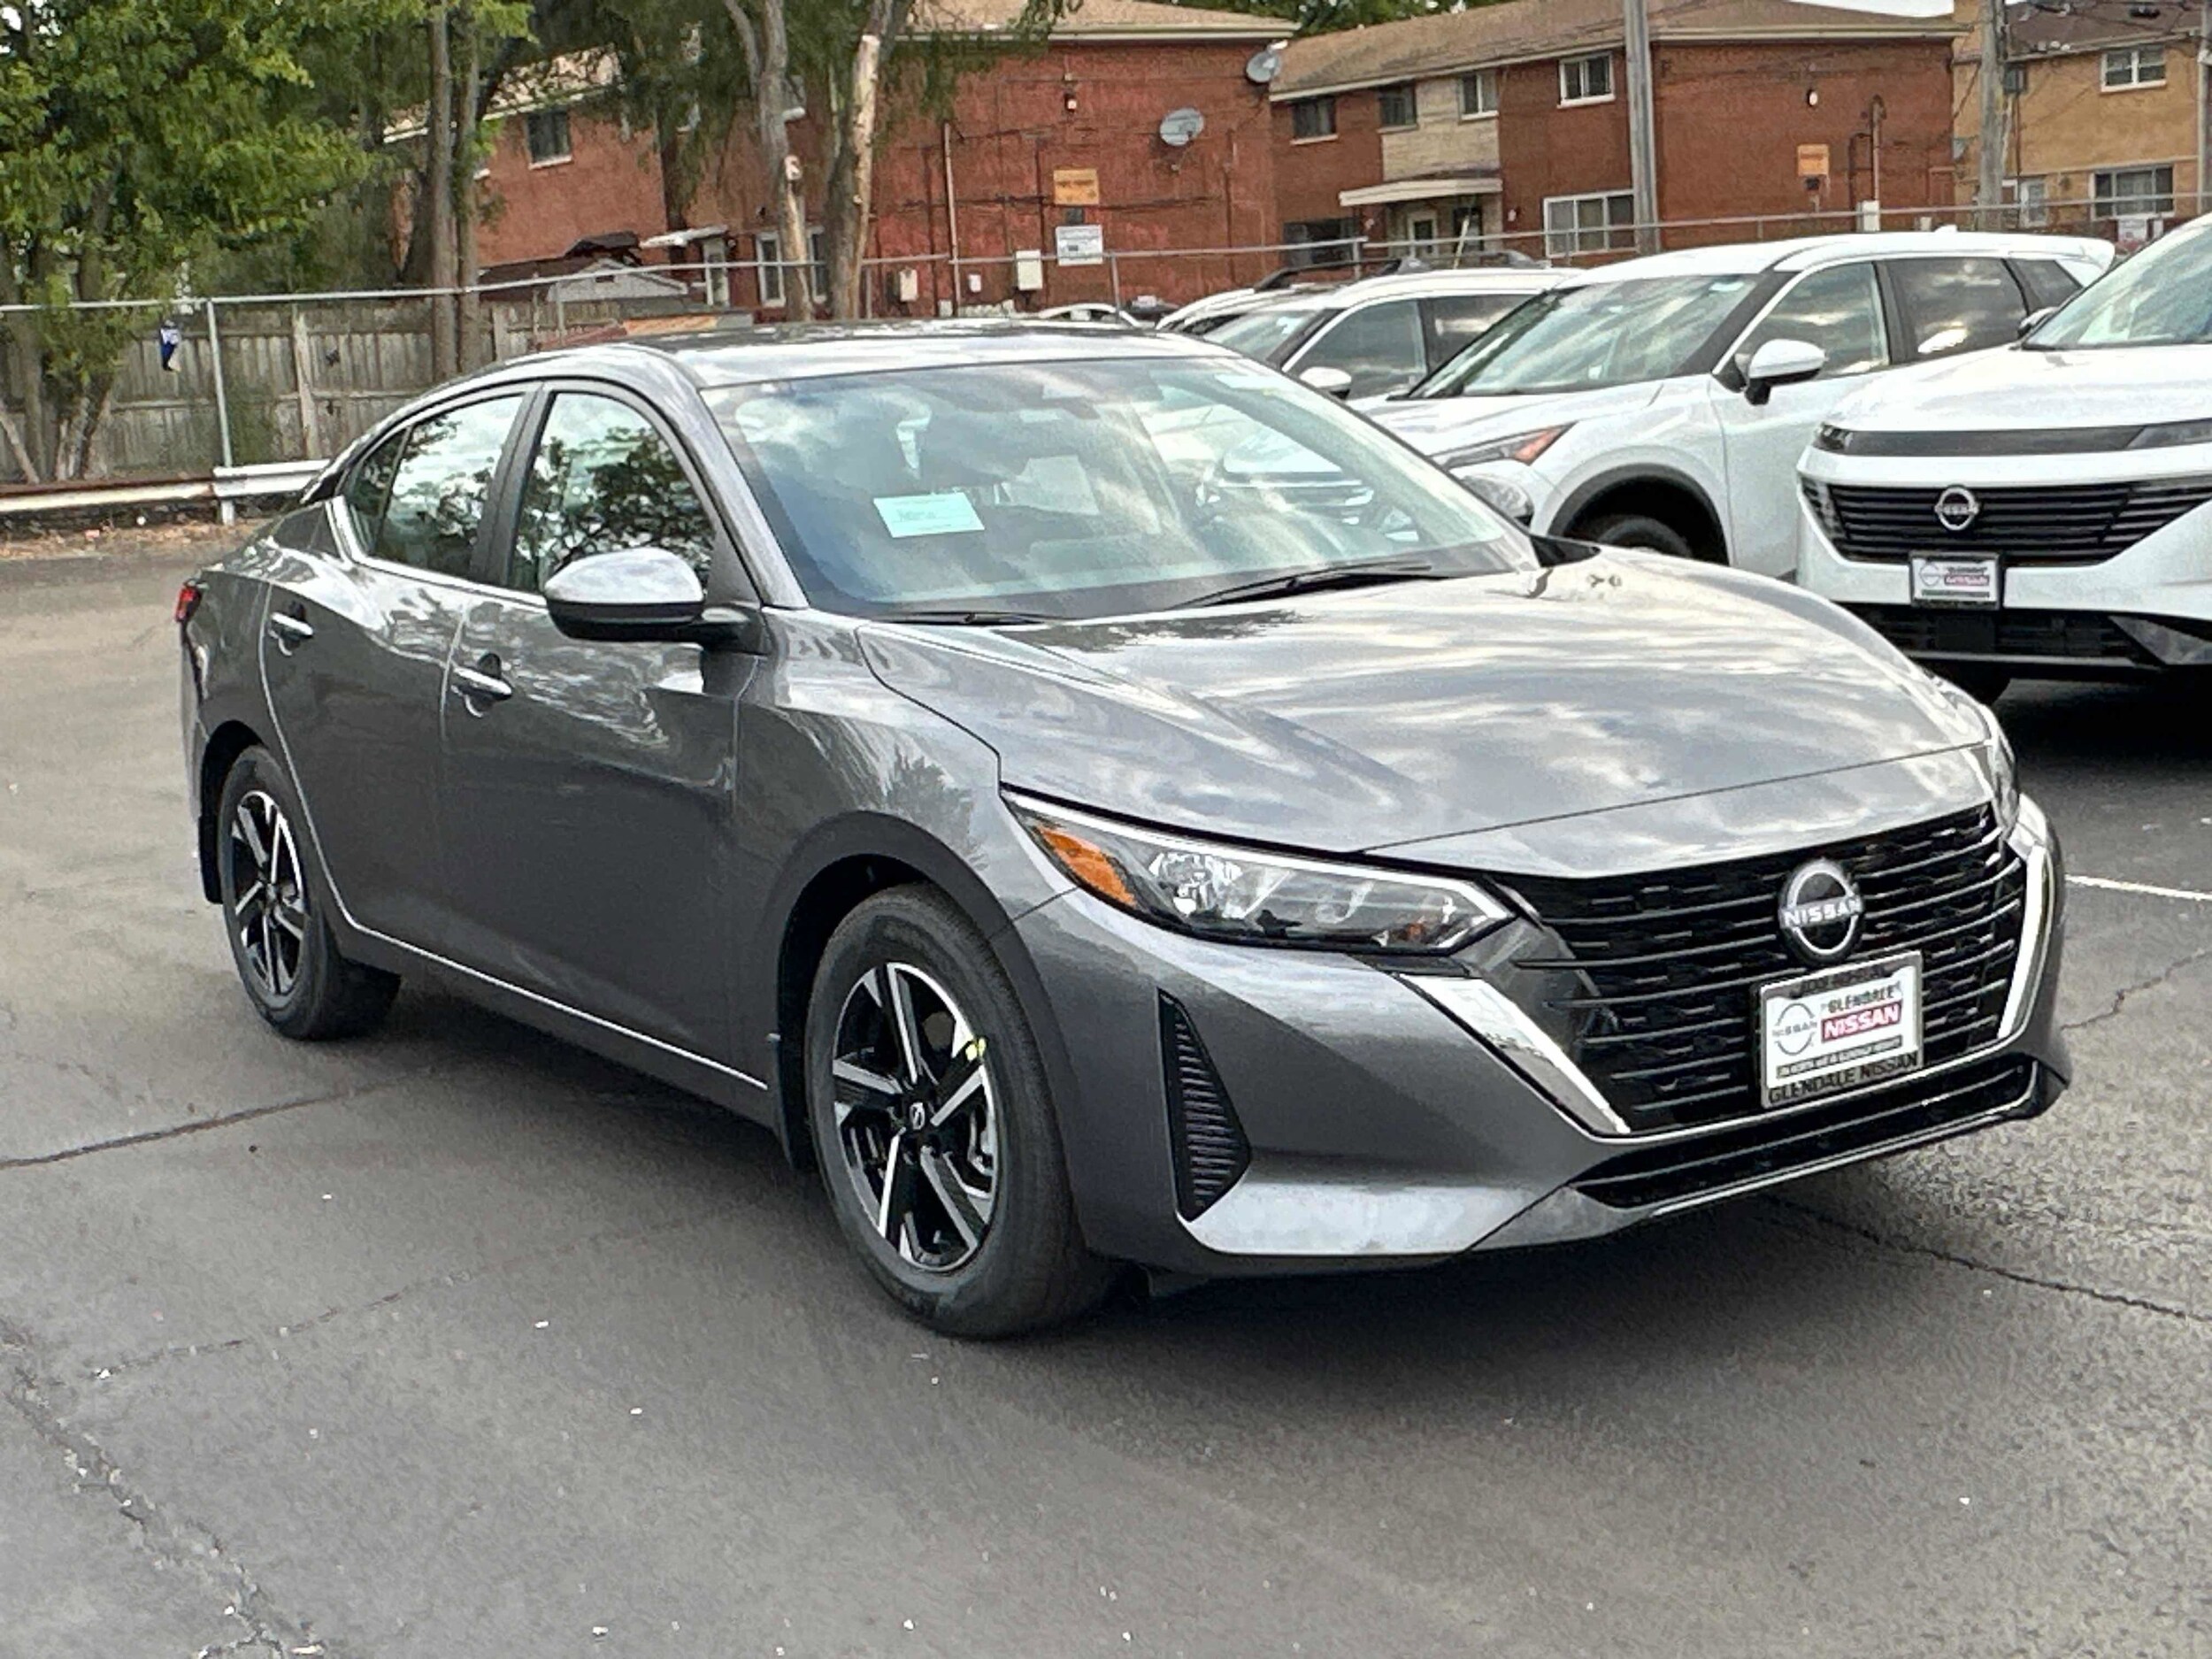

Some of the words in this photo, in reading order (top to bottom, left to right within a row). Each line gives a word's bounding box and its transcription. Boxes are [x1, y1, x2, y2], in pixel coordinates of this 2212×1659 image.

[1783, 898, 1862, 926] NISSAN
[1823, 1002, 1900, 1039] NISSAN
[1770, 1069, 1855, 1103] GLENDALE
[1860, 1049, 1919, 1079] NISSAN
